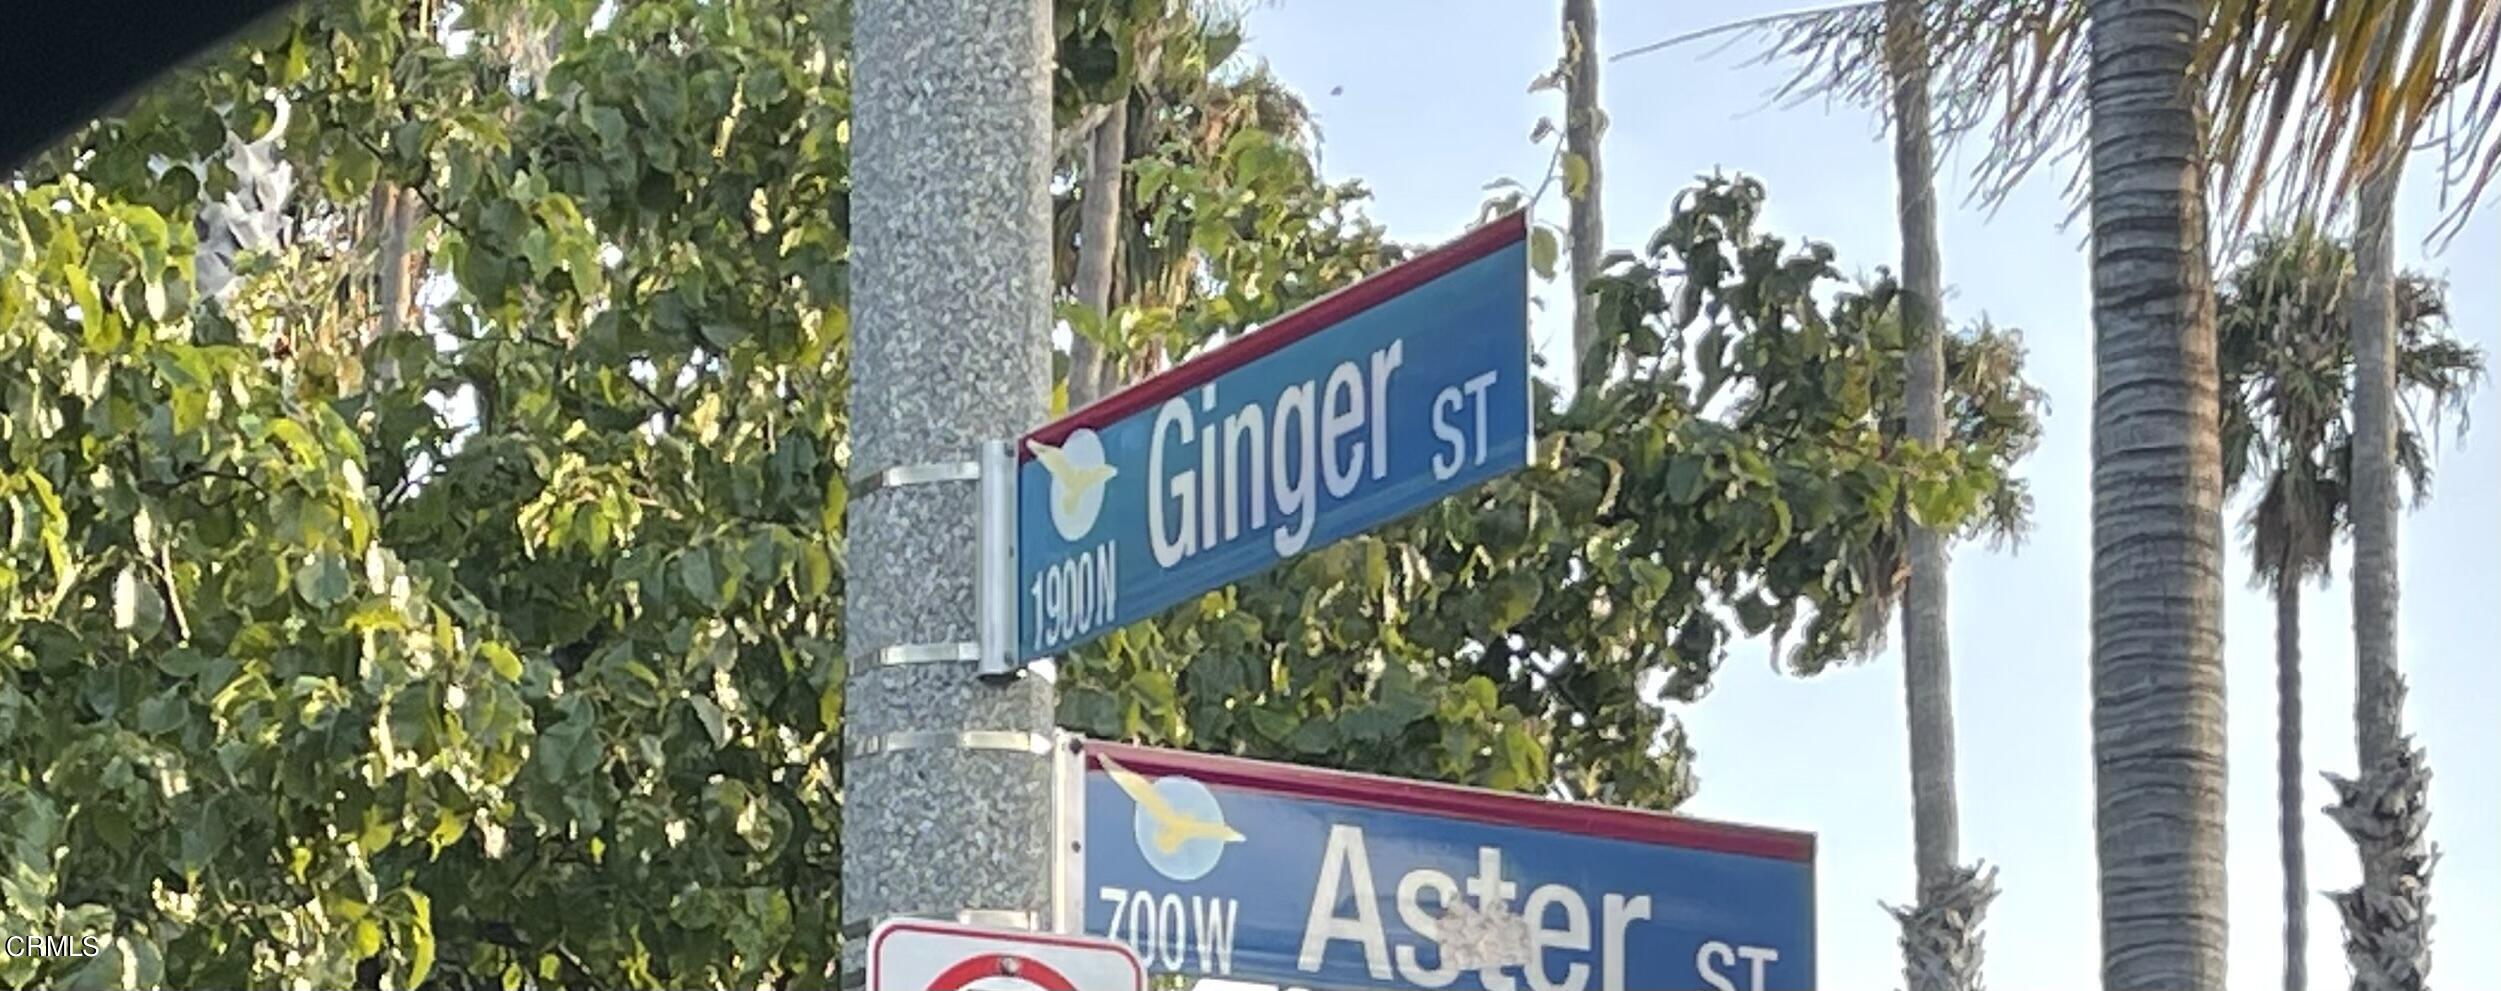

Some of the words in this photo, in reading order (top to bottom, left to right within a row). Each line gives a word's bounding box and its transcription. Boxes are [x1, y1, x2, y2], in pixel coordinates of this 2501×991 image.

[1148, 339, 1403, 568] Ginger
[1431, 370, 1497, 482] ST
[1297, 823, 1651, 991] Aster
[1697, 941, 1778, 991] ST
